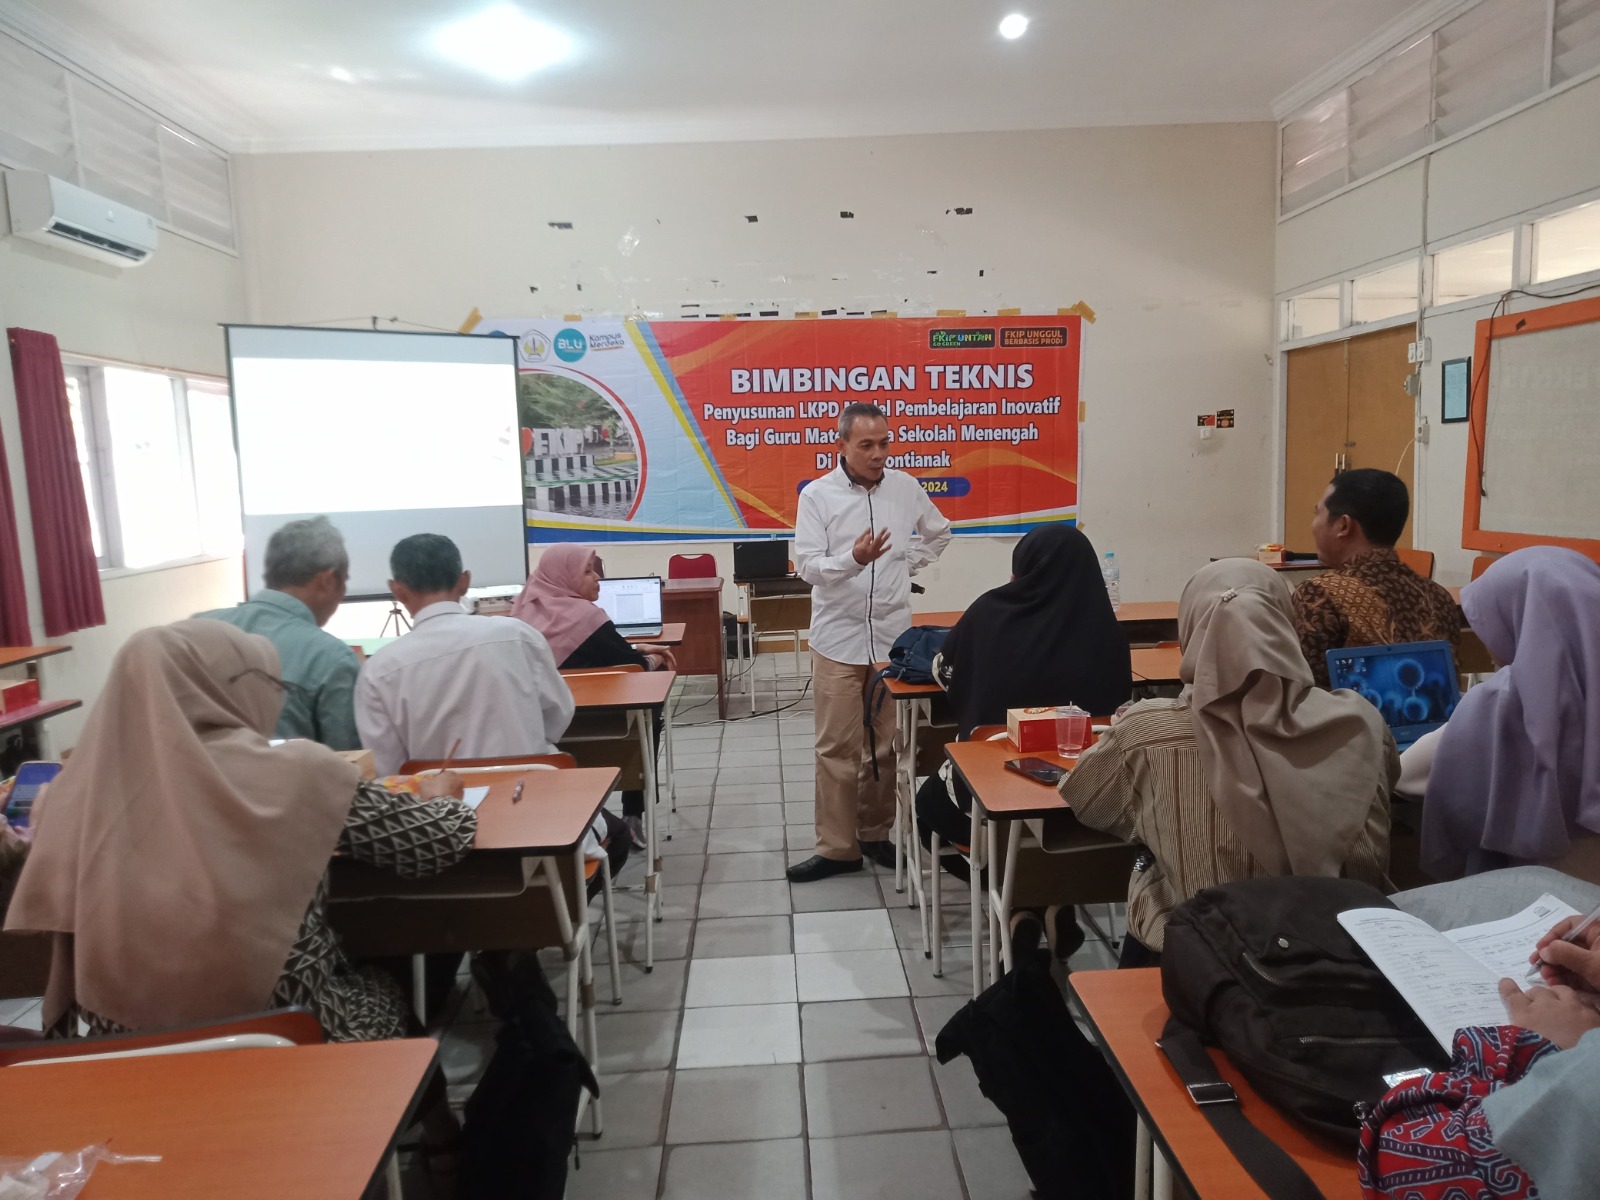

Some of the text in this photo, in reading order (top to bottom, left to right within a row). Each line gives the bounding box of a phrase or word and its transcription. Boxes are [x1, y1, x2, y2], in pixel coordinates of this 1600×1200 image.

[932, 333, 992, 342] FKIP UNTAN
[1005, 330, 1063, 338] FKIP UNGGUL
[557, 338, 583, 349] BLU
[1040, 337, 1063, 345] PRODI
[730, 363, 1035, 394] BIMBINGAN TEKNIS
[703, 403, 795, 425] Penyusunan
[799, 401, 840, 418] LKPD
[895, 398, 997, 420] Pembelajaran
[1001, 396, 1062, 415] Inovatif
[726, 428, 760, 450] Bagi
[764, 428, 801, 445] Guru
[898, 424, 957, 442] Sekolah
[960, 422, 1039, 445] Menengah
[816, 452, 832, 469] Di
[885, 450, 951, 468] ontianak
[921, 481, 949, 493] 2024
